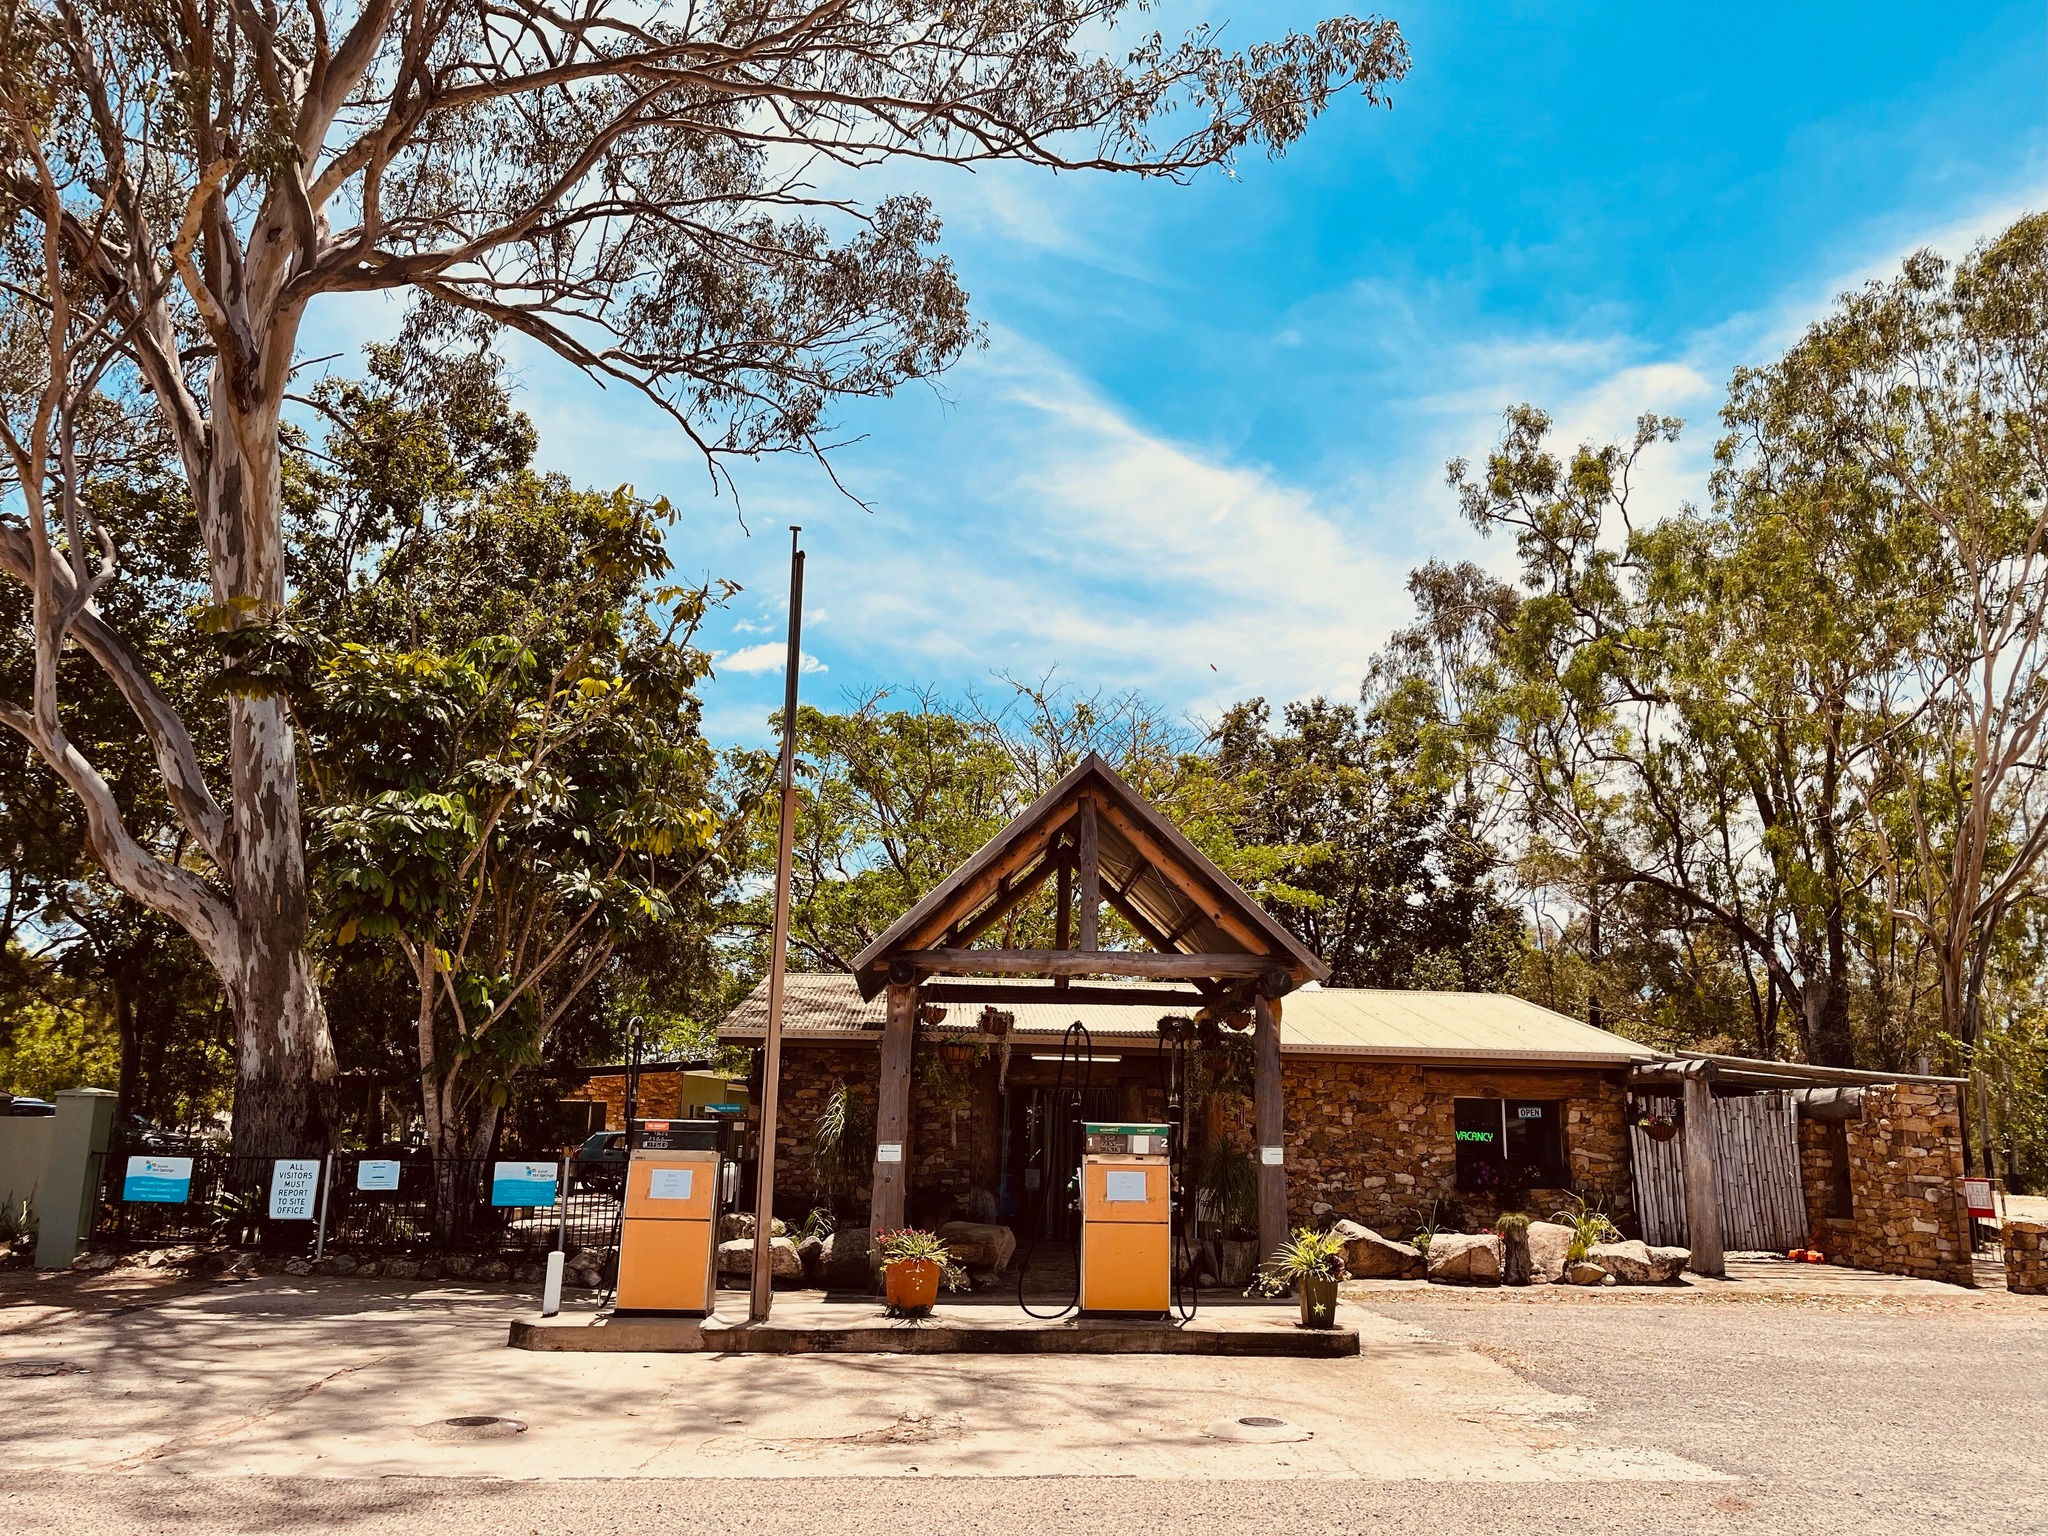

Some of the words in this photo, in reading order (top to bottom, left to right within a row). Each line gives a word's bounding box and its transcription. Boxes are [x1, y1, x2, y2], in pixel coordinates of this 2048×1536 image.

[1520, 1108, 1540, 1117] OPEN
[1455, 1131, 1493, 1142] VACANCY
[1087, 1137, 1093, 1147] 1
[1160, 1138, 1168, 1148] 2
[278, 1189, 308, 1197] REPORT
[1967, 1184, 1988, 1195] KEEP
[1971, 1195, 1988, 1206] OUT
